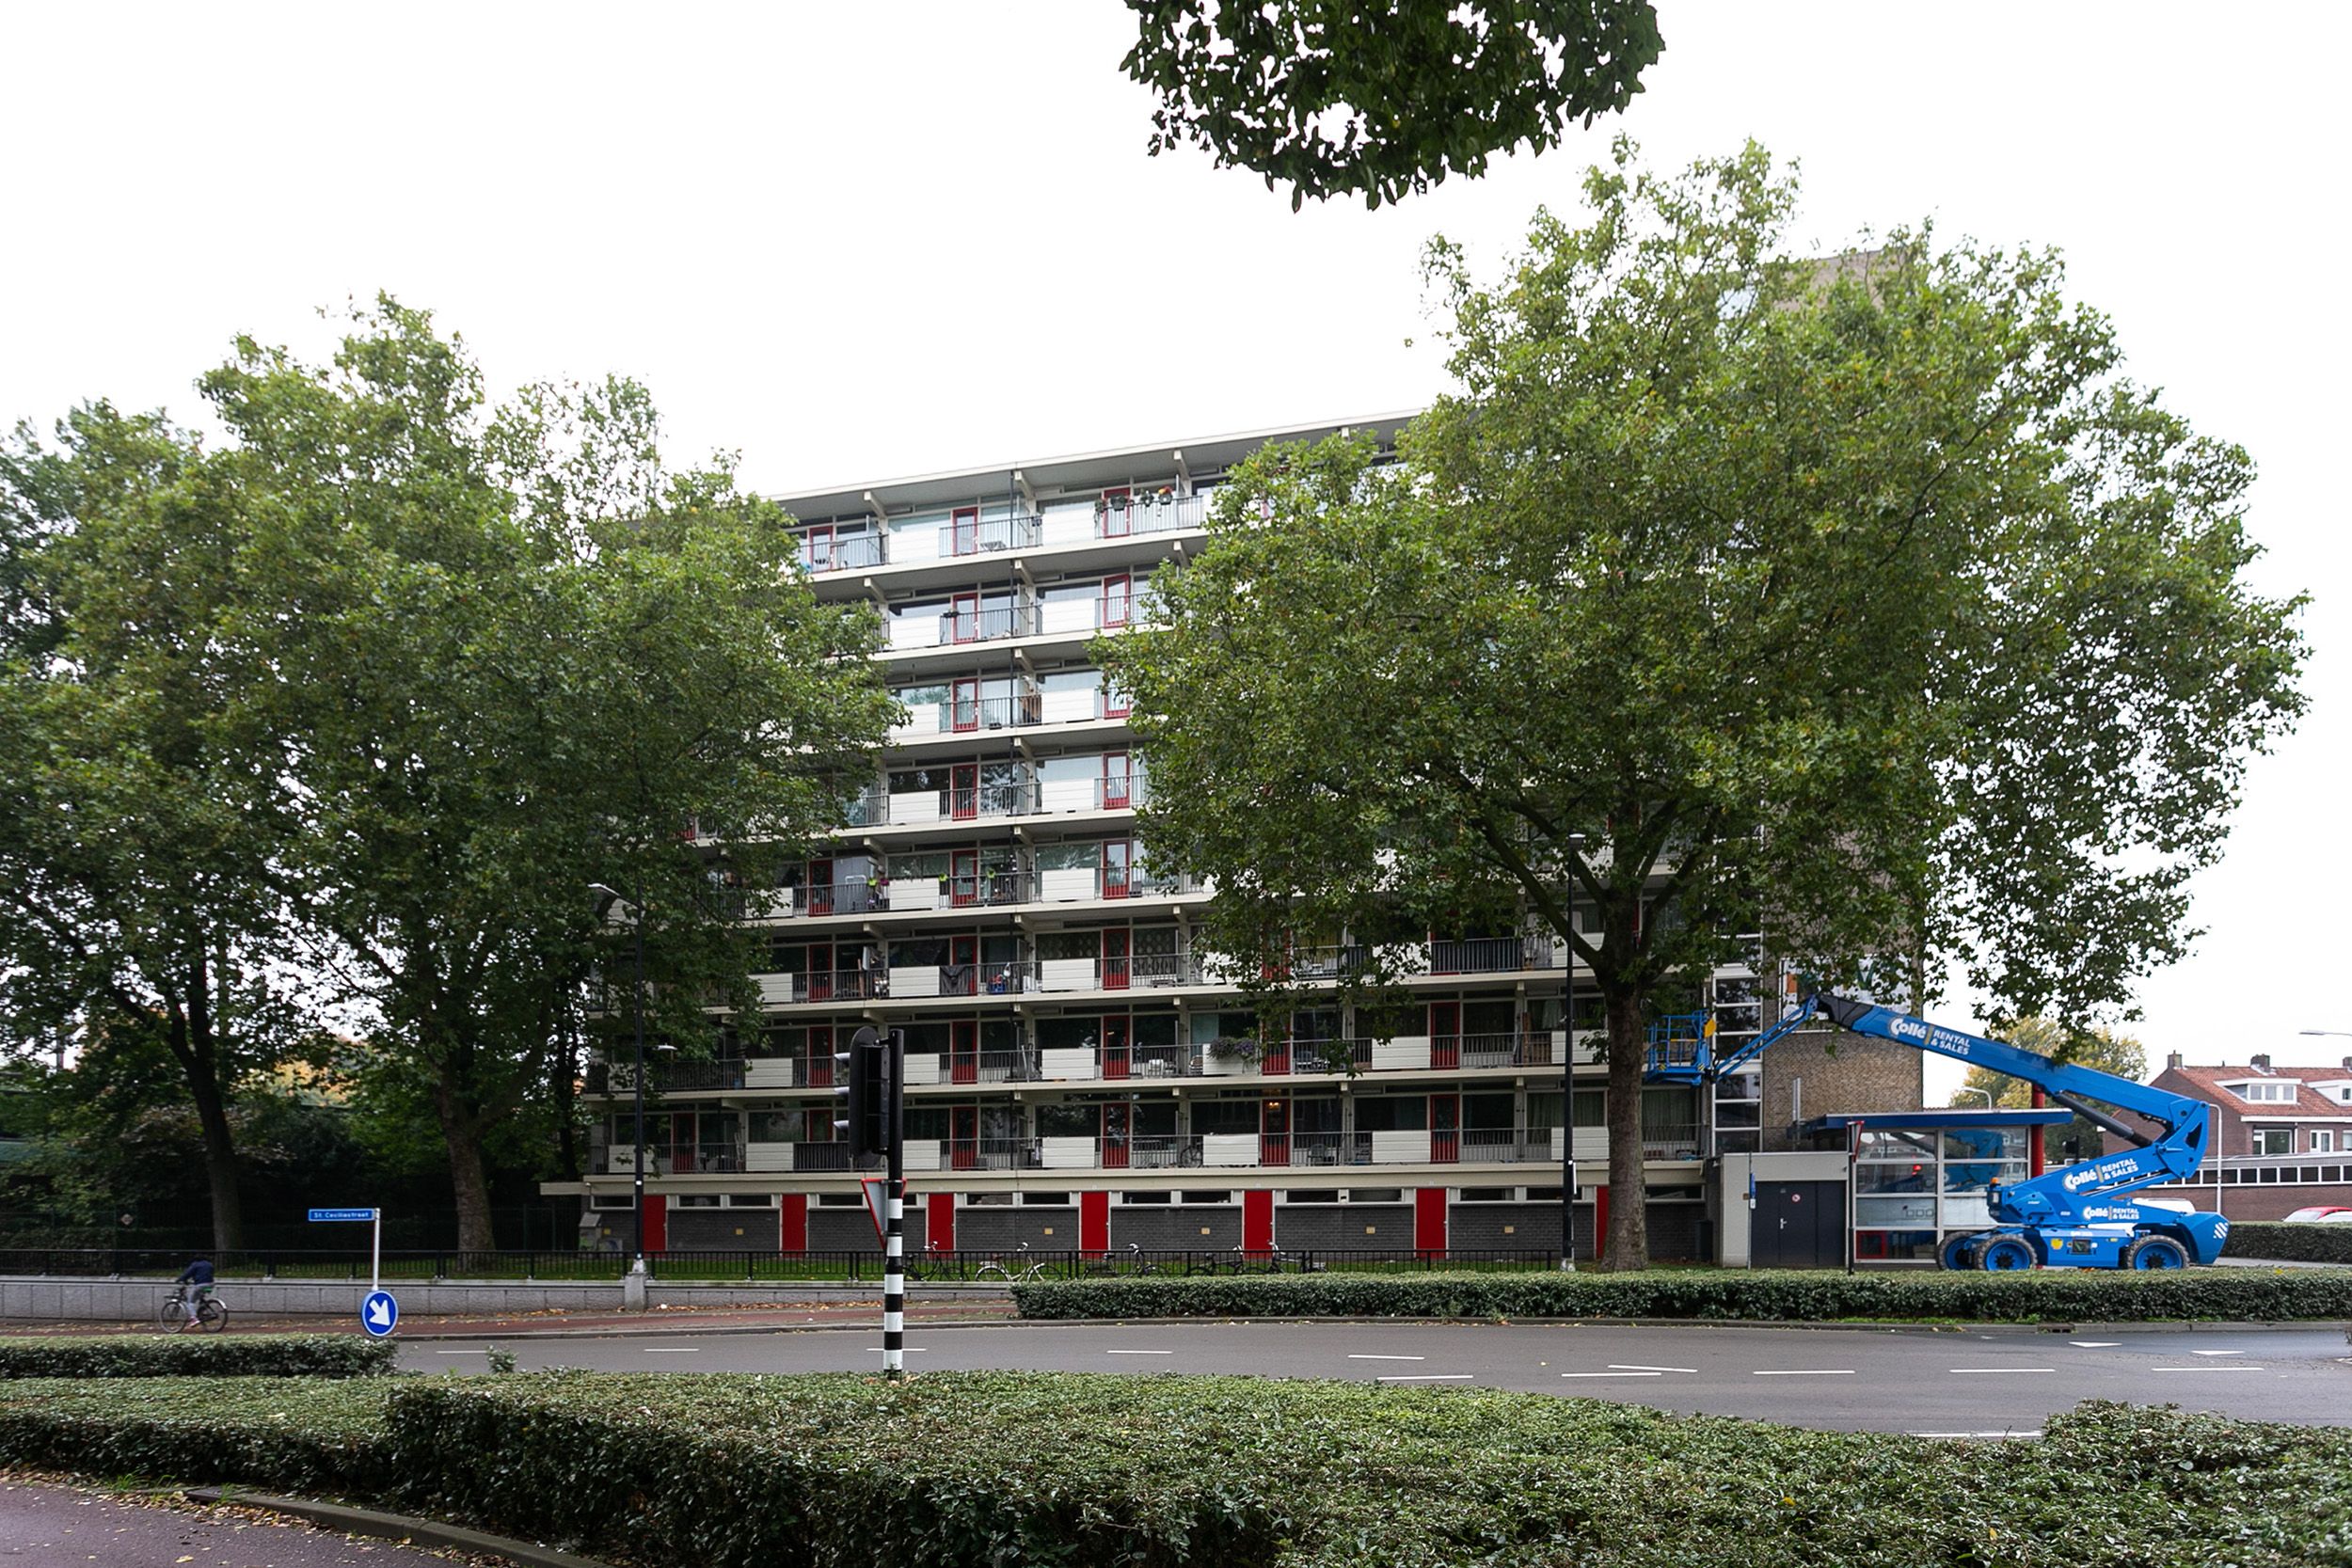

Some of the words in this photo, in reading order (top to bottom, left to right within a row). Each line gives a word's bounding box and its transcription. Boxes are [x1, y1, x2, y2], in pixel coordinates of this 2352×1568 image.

[1890, 1018, 1926, 1038] Collé
[1933, 1030, 1970, 1047] RENTAL
[1939, 1041, 1969, 1055] SALES
[2102, 1158, 2137, 1173] RENTAL
[2111, 1164, 2138, 1178] SALES
[2063, 1168, 2098, 1191] Collé
[2083, 1206, 2108, 1220] Collé
